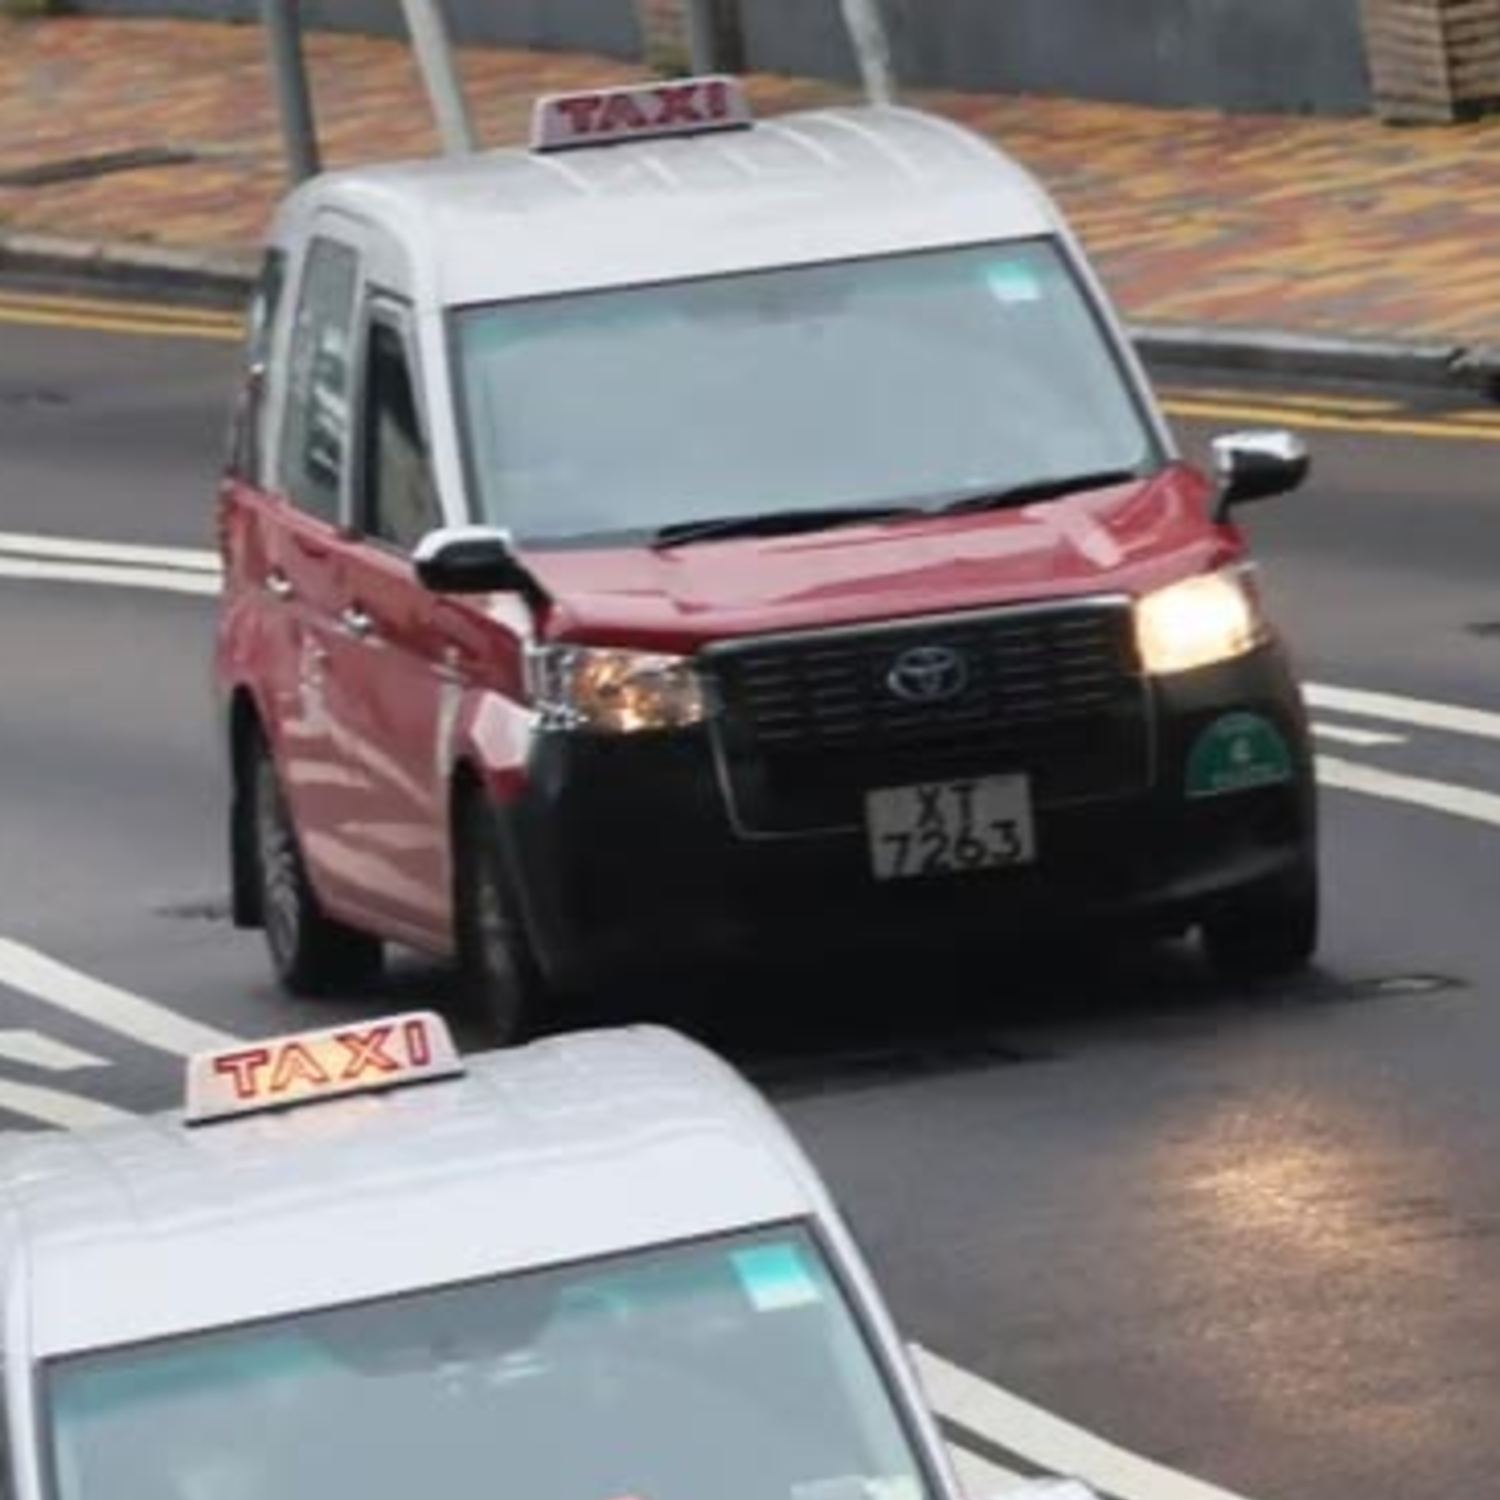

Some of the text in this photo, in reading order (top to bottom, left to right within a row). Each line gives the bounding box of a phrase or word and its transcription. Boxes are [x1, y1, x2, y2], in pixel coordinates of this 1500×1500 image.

[557, 80, 728, 133] TAXI
[916, 782, 976, 829] XT
[882, 819, 1022, 874] 7263
[213, 1019, 431, 1098] TAXI
